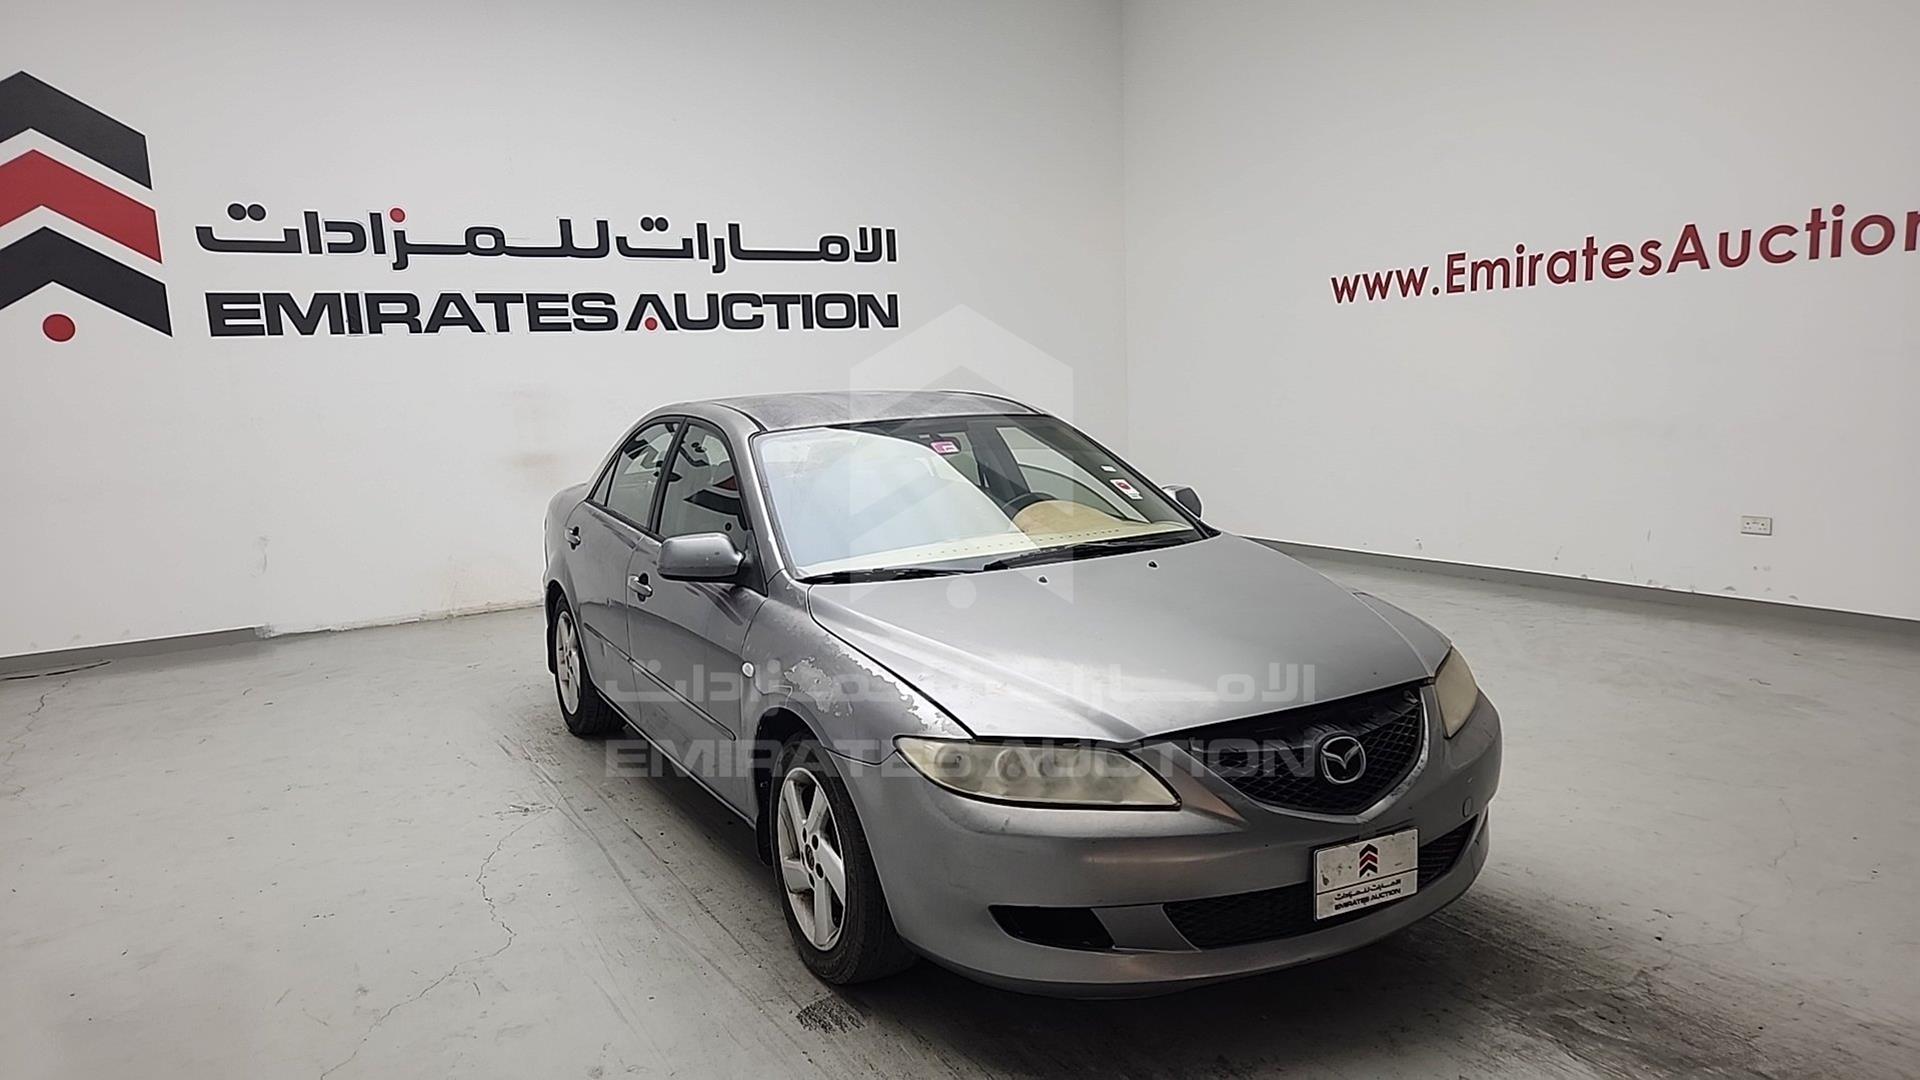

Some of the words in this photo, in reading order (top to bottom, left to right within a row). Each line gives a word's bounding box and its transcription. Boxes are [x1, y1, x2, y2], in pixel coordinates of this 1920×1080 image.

[196, 204, 609, 271] للمزادات
[205, 293, 620, 337] EMIRATES
[625, 293, 900, 333] AUCTION
[1334, 896, 1370, 910] EMIRATES
[1370, 888, 1402, 901] AUCTION
